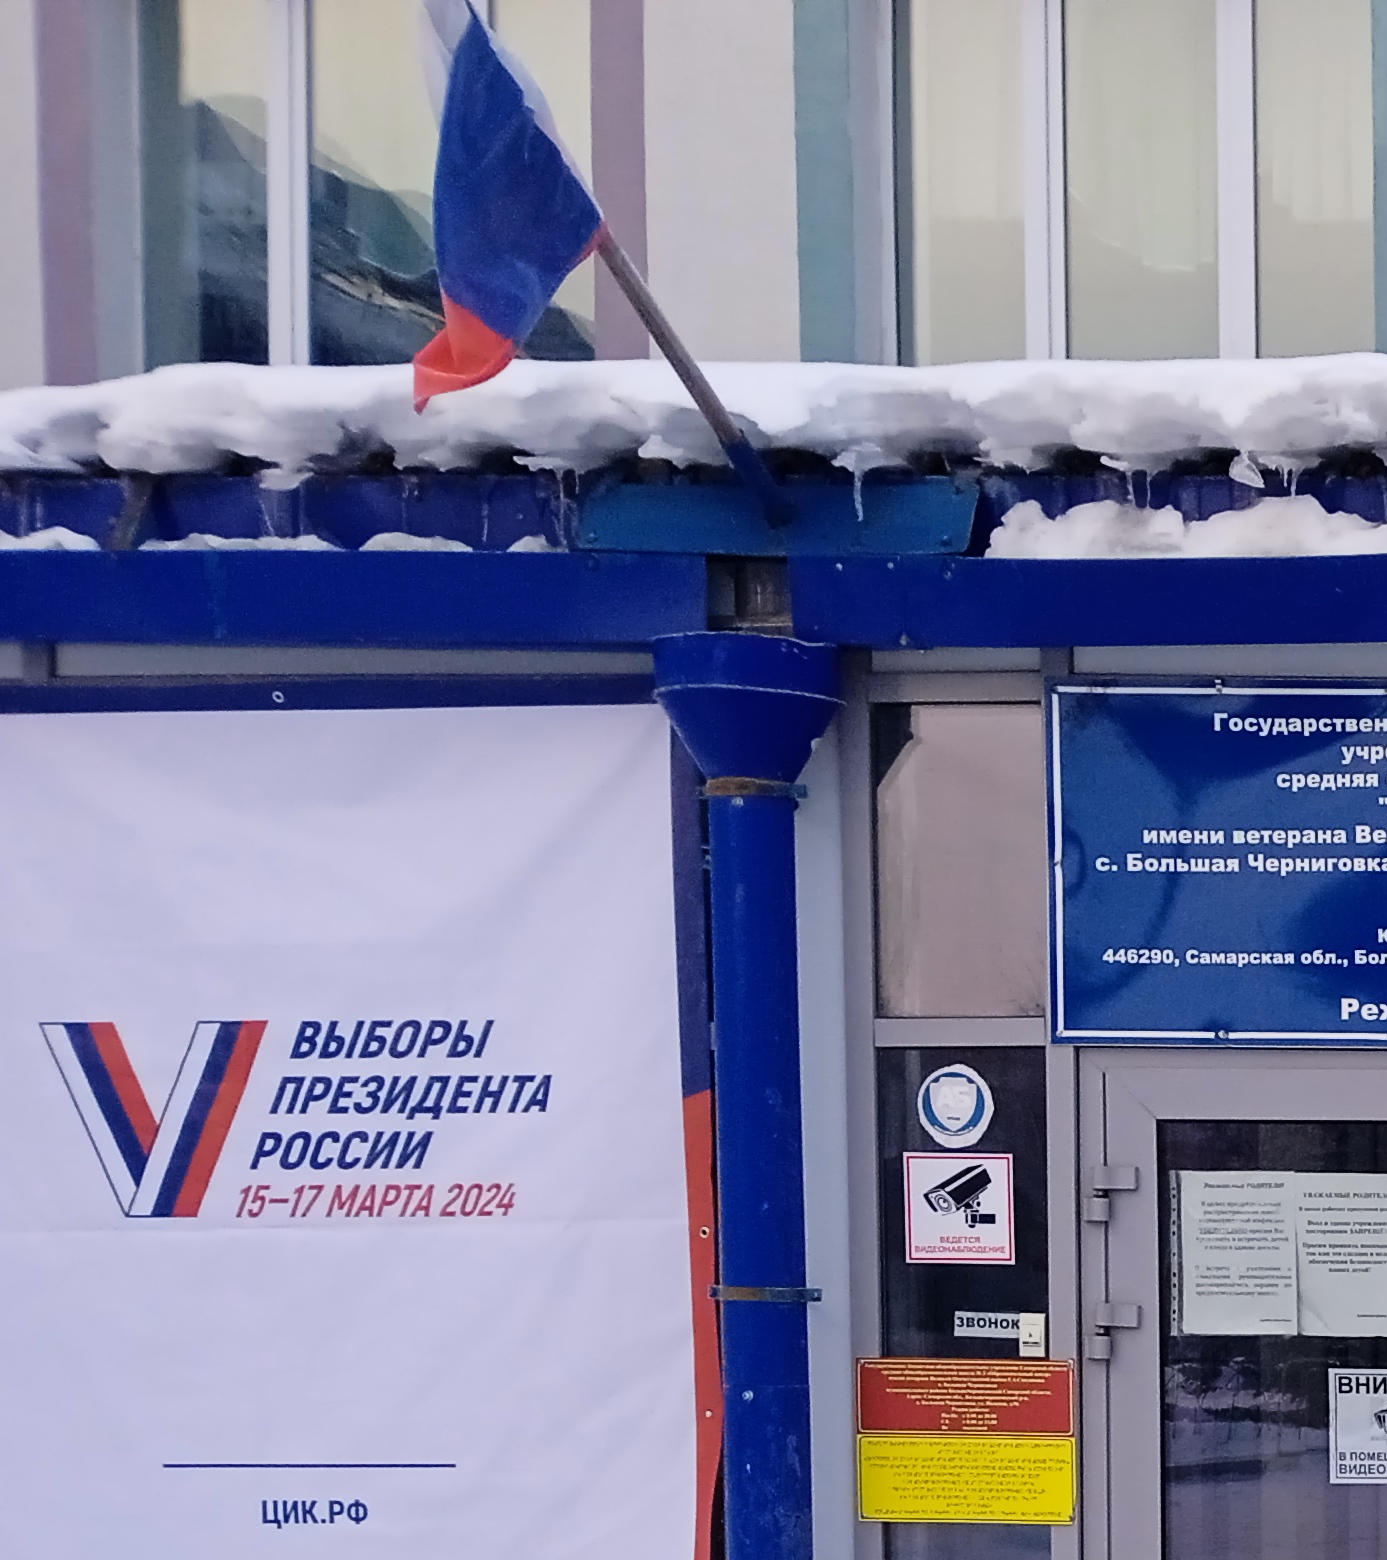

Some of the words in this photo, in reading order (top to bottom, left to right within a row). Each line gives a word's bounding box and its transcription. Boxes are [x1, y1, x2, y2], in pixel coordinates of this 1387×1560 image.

[1277, 774, 1379, 792] средняя
[1144, 830, 1224, 844] имени
[1233, 830, 1347, 848] ветерана
[1096, 858, 1118, 871] с.
[1127, 854, 1239, 872] Большая
[1103, 949, 1180, 967] 446290,
[1186, 950, 1295, 967] Самарская
[1301, 950, 1348, 967] обл.,
[290, 1020, 494, 1059] ВЫБОРЫ
[270, 1075, 552, 1120] ПРЕЗИДЕНТА
[250, 1131, 434, 1170] РОССИИ
[326, 1184, 435, 1218] МАРТА
[439, 1184, 516, 1217] 2024
[940, 1236, 980, 1244] ВЕДЕТСЯ
[956, 1317, 1020, 1330] ЗВОНОК
[1339, 1452, 1347, 1461] В
[262, 1500, 368, 1529] ЦИК.РФ
